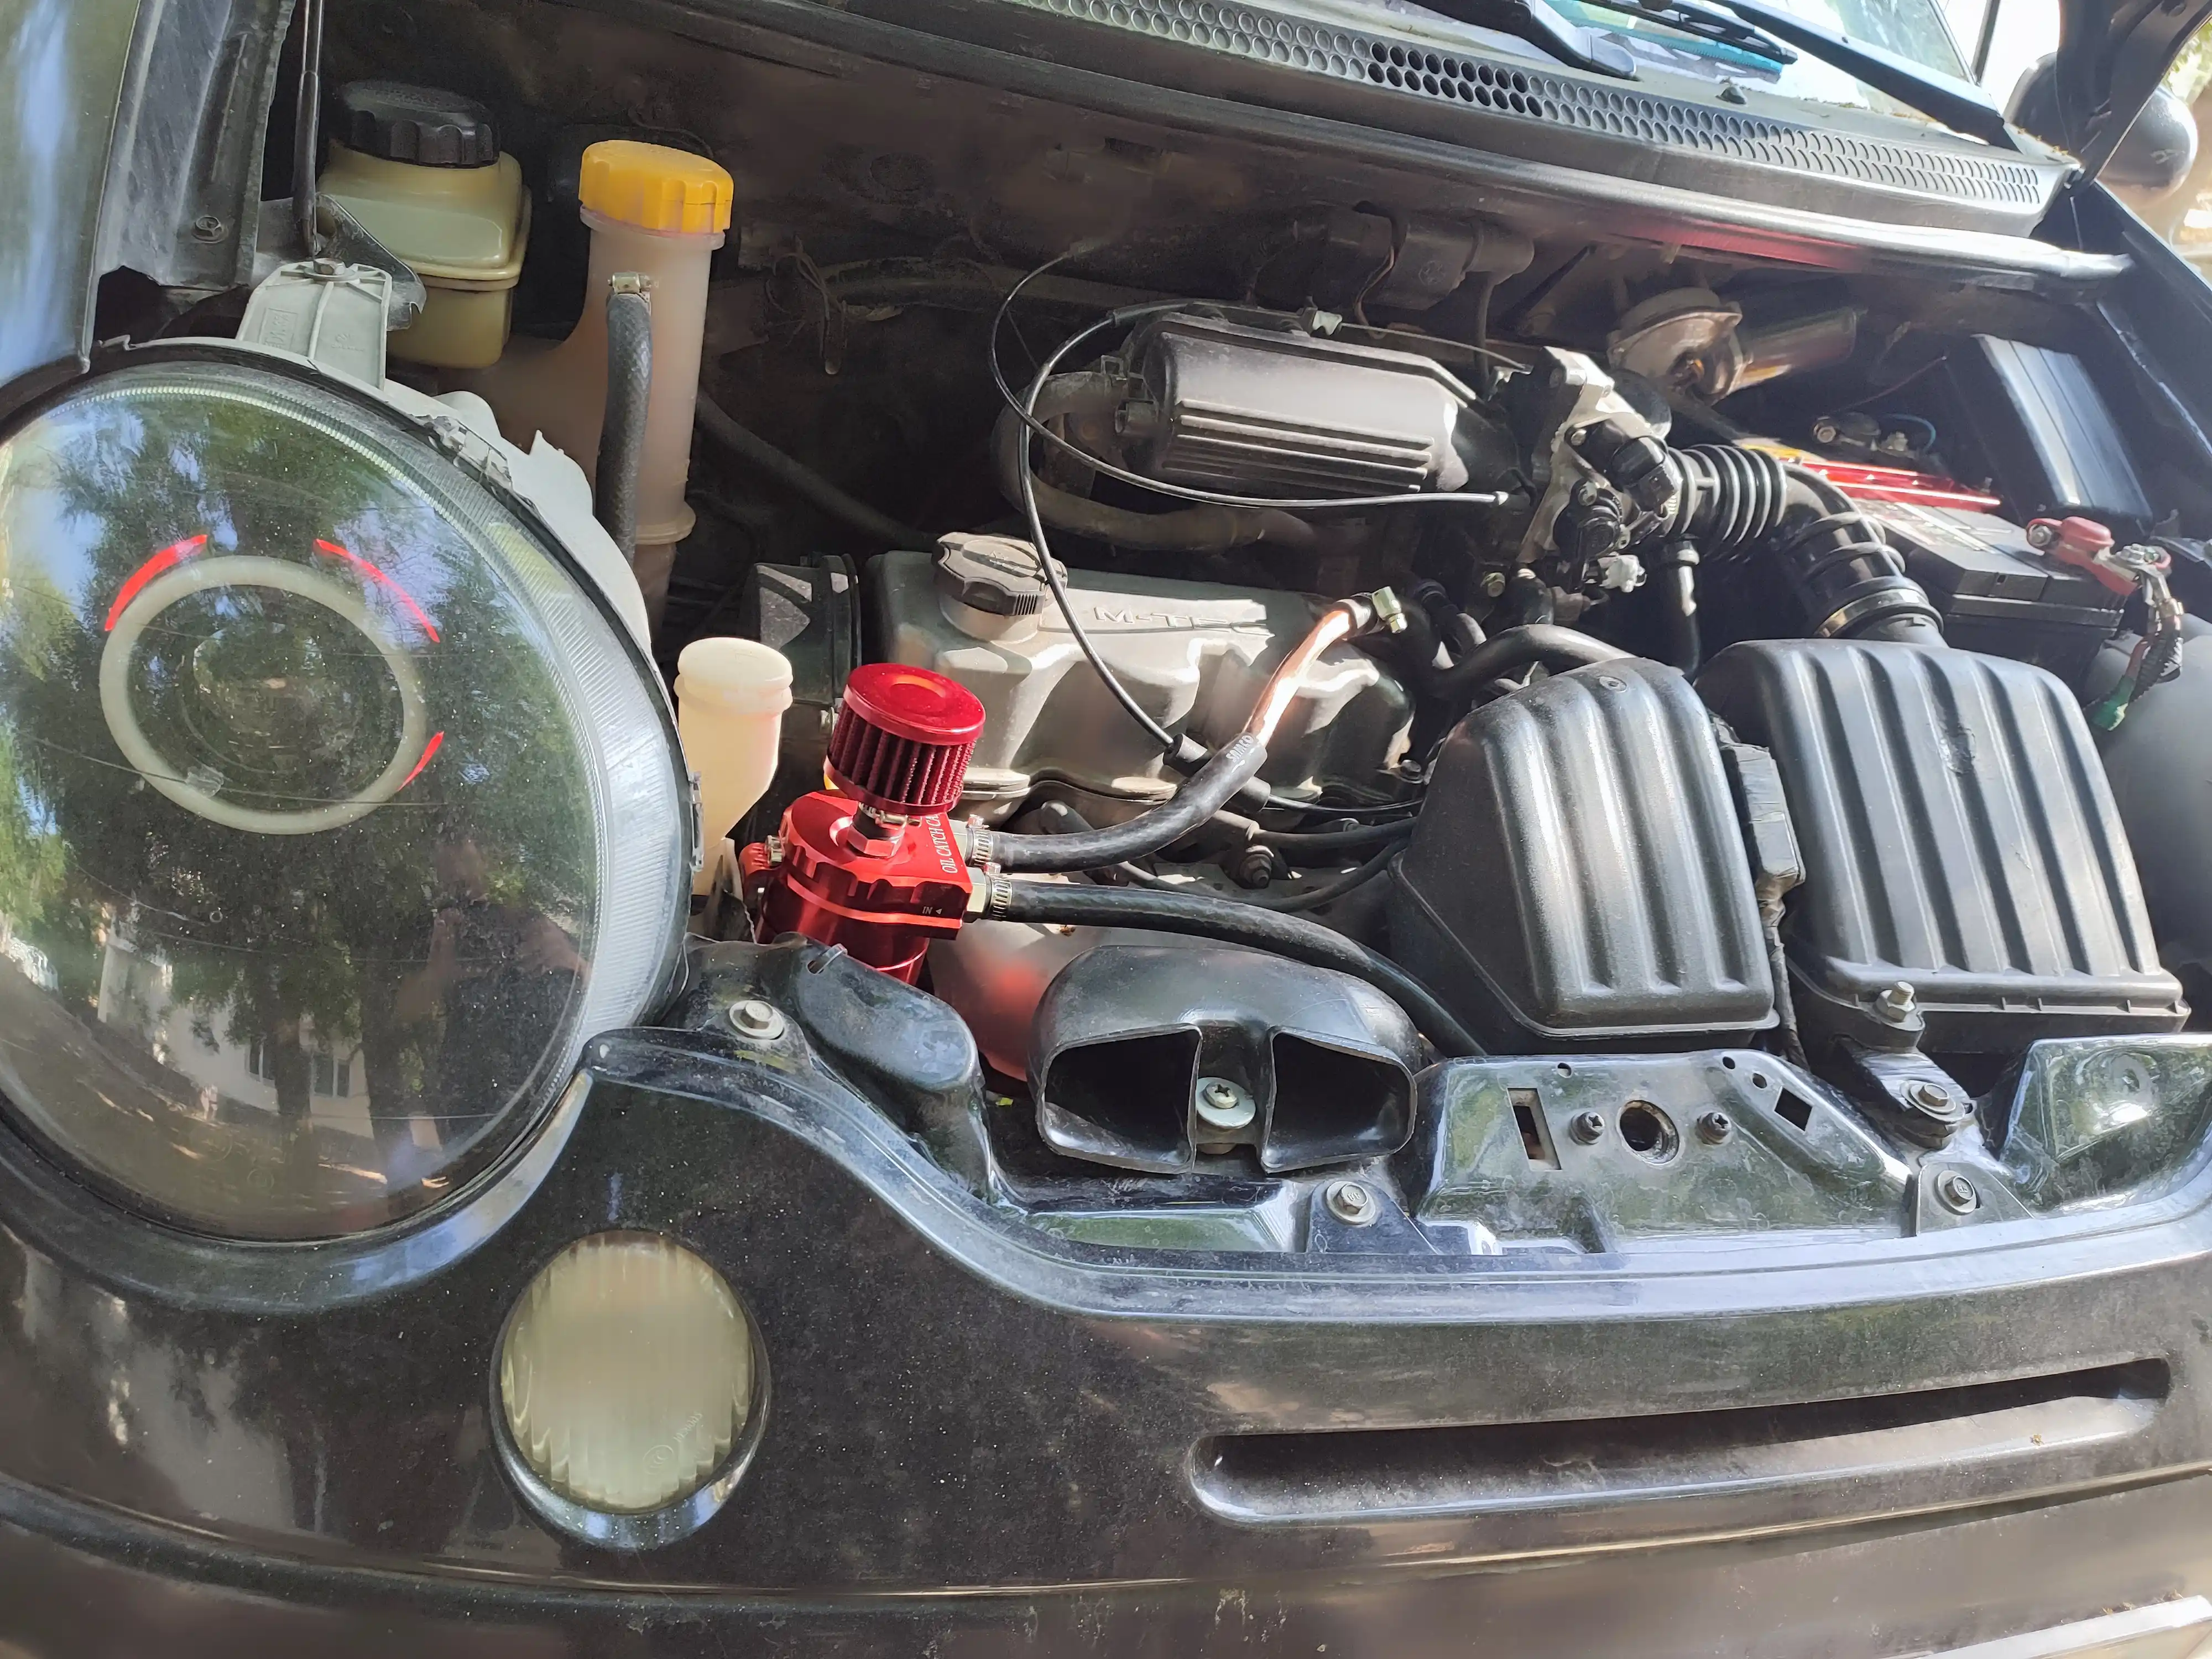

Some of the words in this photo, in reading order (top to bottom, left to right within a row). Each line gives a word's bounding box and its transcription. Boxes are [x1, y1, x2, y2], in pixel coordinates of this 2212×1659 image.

[1093, 606, 1275, 637] M-TEC
[925, 814, 941, 827] CA
[928, 827, 952, 856] CATCH
[940, 858, 958, 873] OIL
[922, 906, 933, 914] IN
